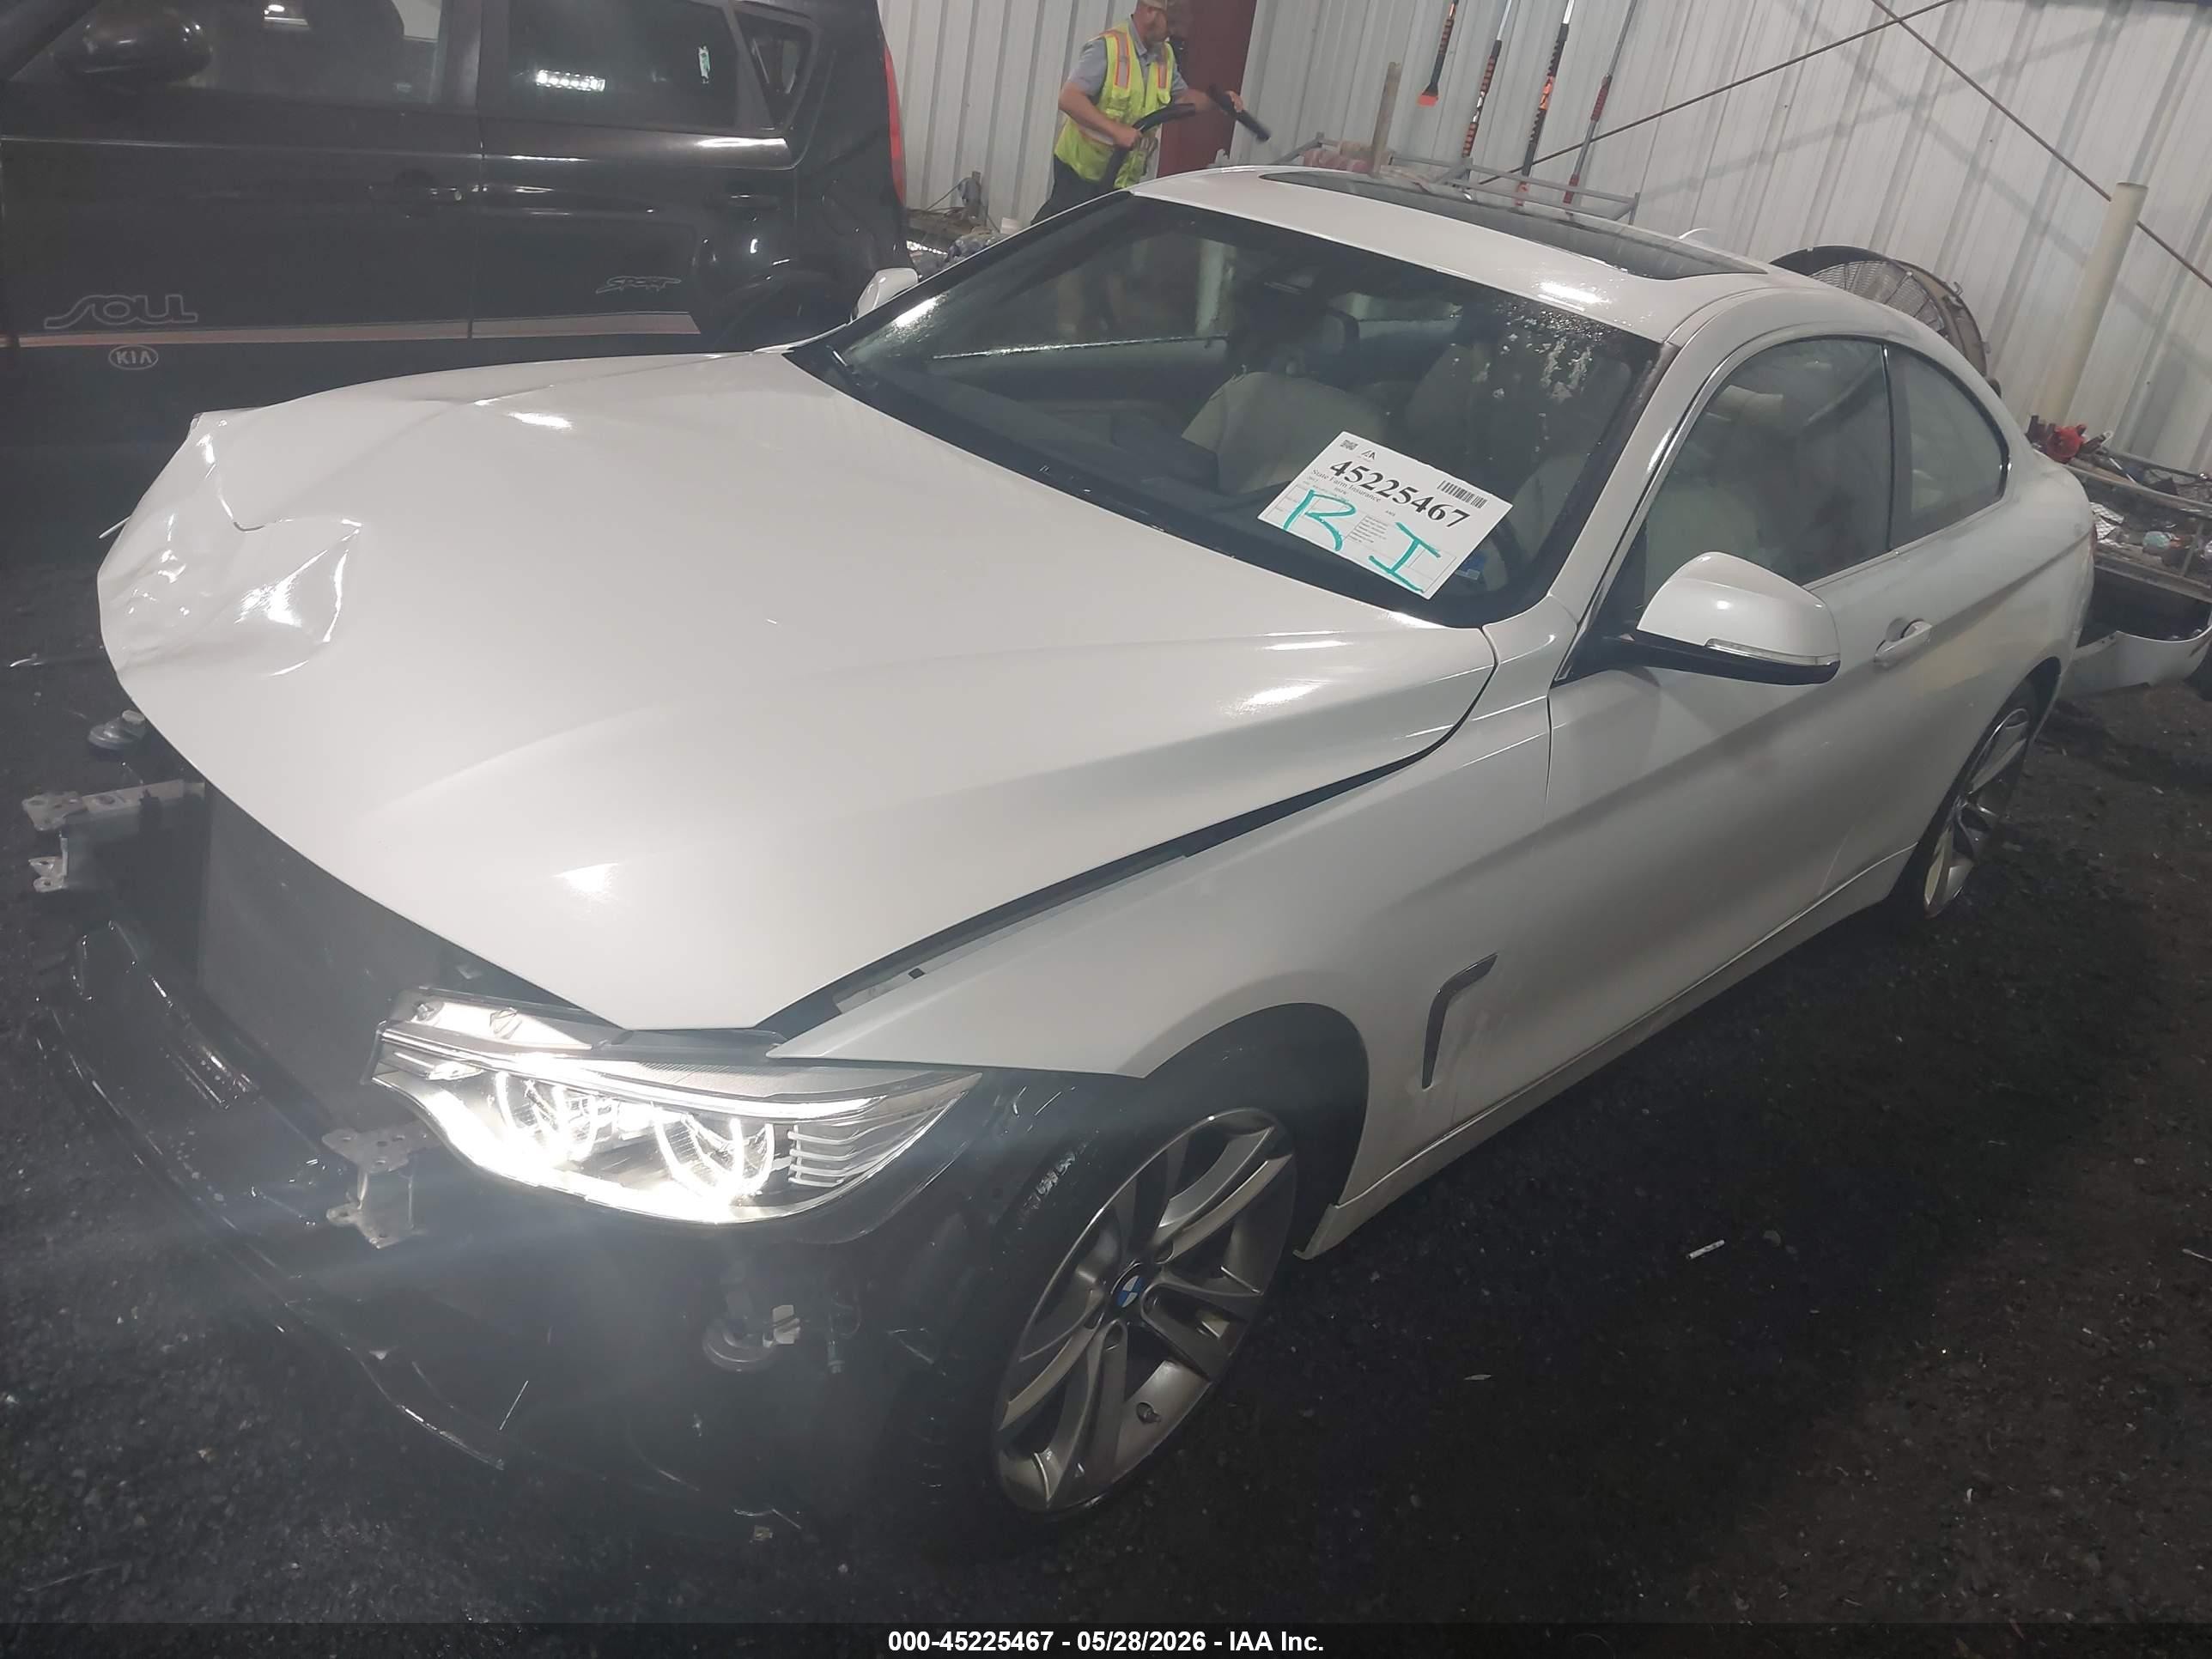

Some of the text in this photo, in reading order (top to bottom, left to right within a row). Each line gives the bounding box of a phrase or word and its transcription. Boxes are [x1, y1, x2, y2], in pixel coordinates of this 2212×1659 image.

[1311, 469, 1329, 479] State
[1329, 476, 1348, 488] Farm
[1348, 483, 1382, 502] Insurance
[1330, 460, 1470, 527] 45225467
